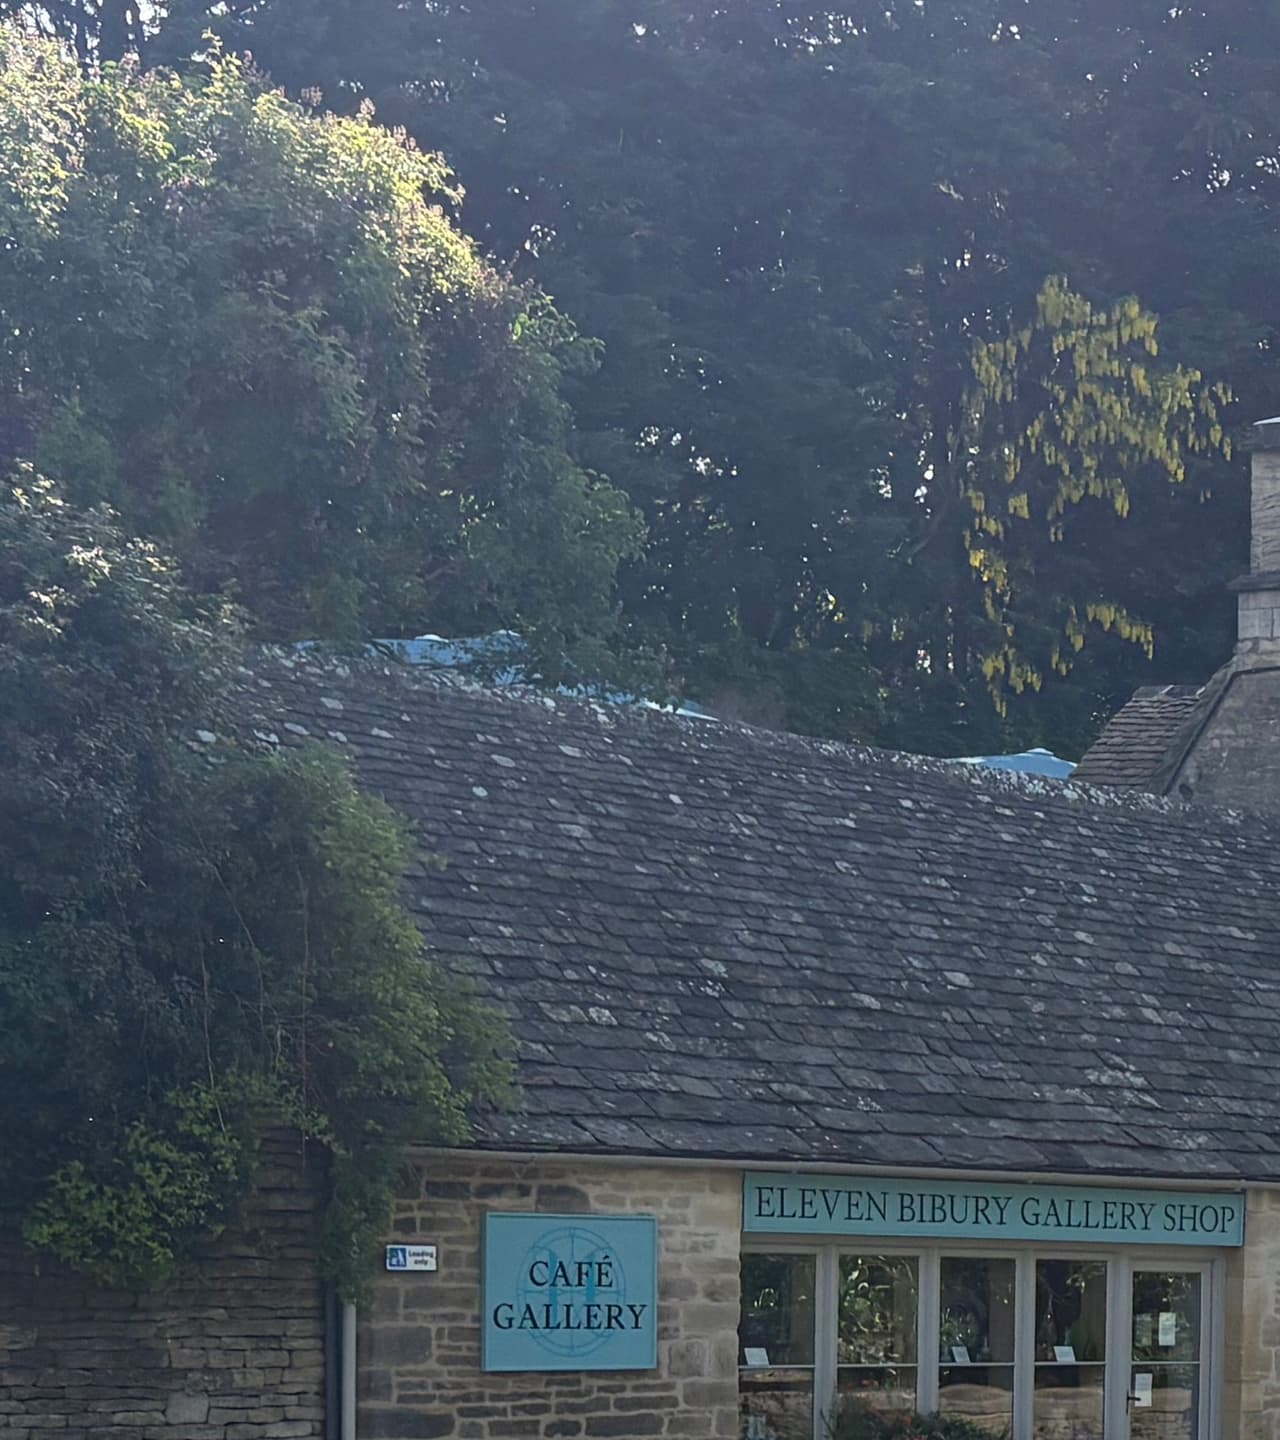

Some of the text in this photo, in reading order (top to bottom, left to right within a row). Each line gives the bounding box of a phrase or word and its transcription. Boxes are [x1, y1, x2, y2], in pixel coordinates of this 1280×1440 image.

[755, 1187, 1235, 1233] ELEVEN BIBURY GALLERY SHOP
[528, 1254, 614, 1288] CAFÉ
[492, 1302, 648, 1330] GALLERY
